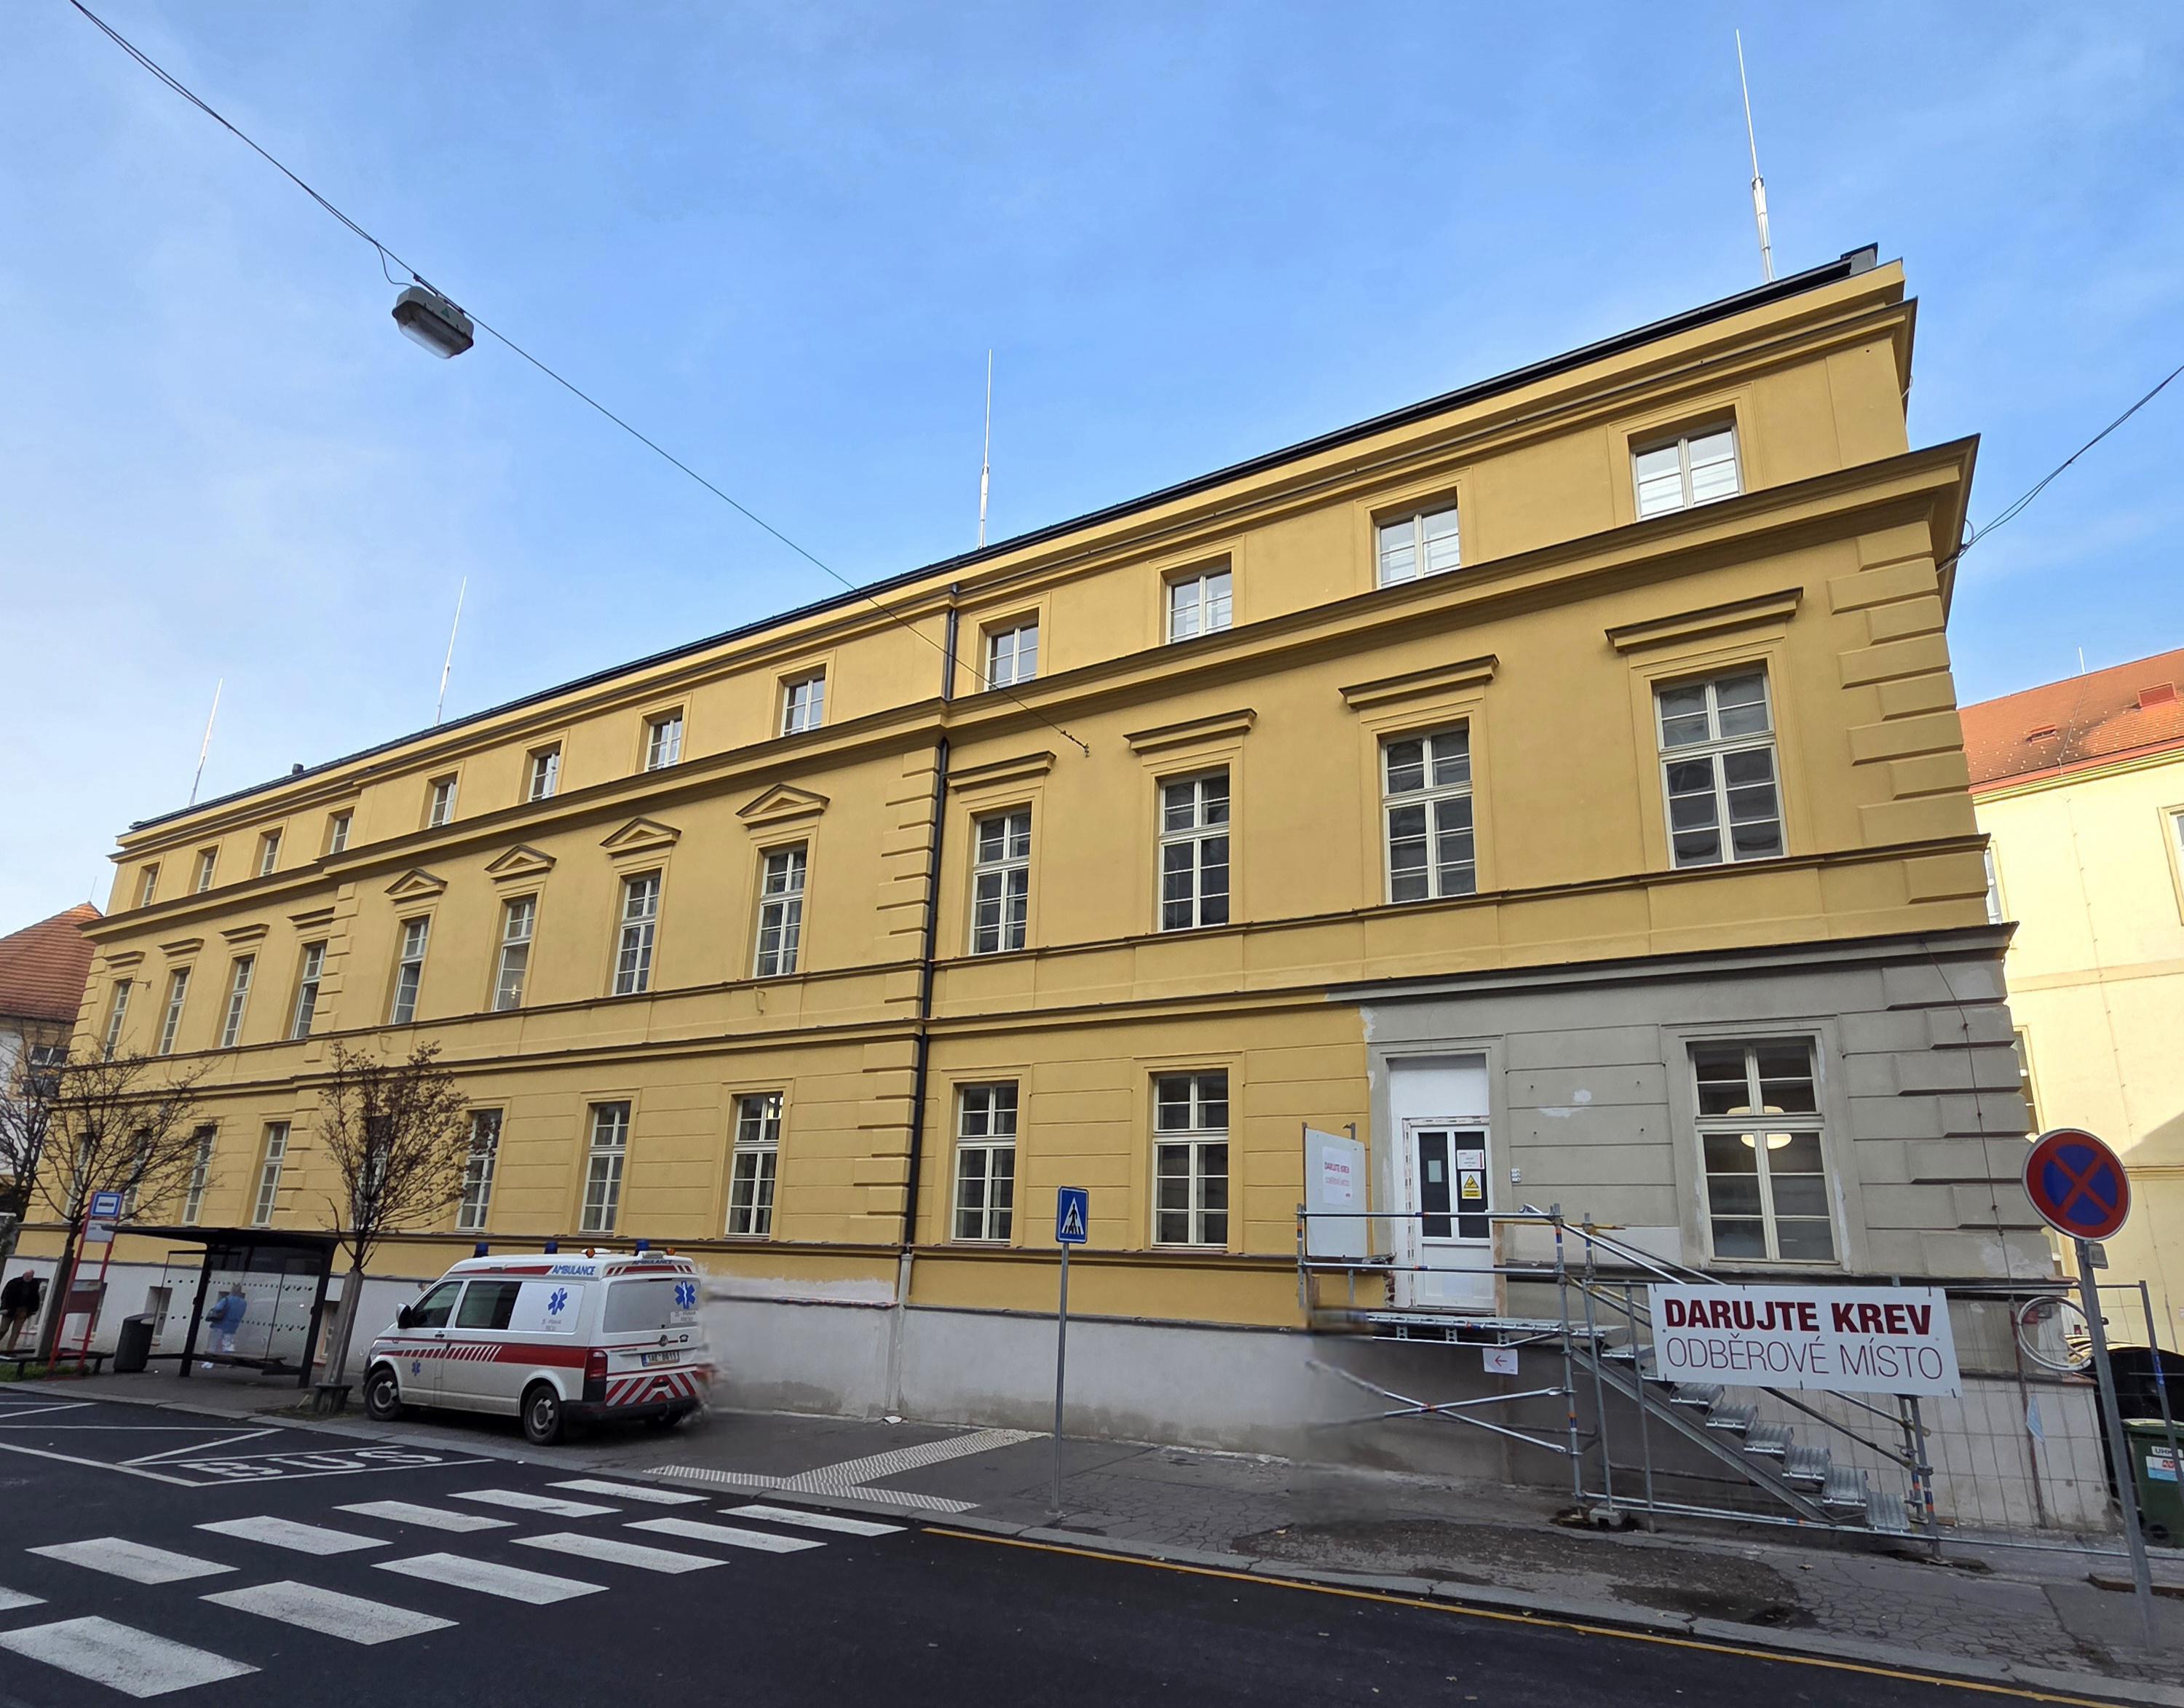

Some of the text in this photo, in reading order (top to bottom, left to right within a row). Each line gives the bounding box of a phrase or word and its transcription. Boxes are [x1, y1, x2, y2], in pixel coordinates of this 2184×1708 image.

[552, 1265, 596, 1276] AMBULANCE
[1663, 1299, 1931, 1335] DARUJTE KREV
[1666, 1332, 1944, 1380] ODBĚROVÉ MÍSTO
[178, 1450, 443, 1477] BUS
